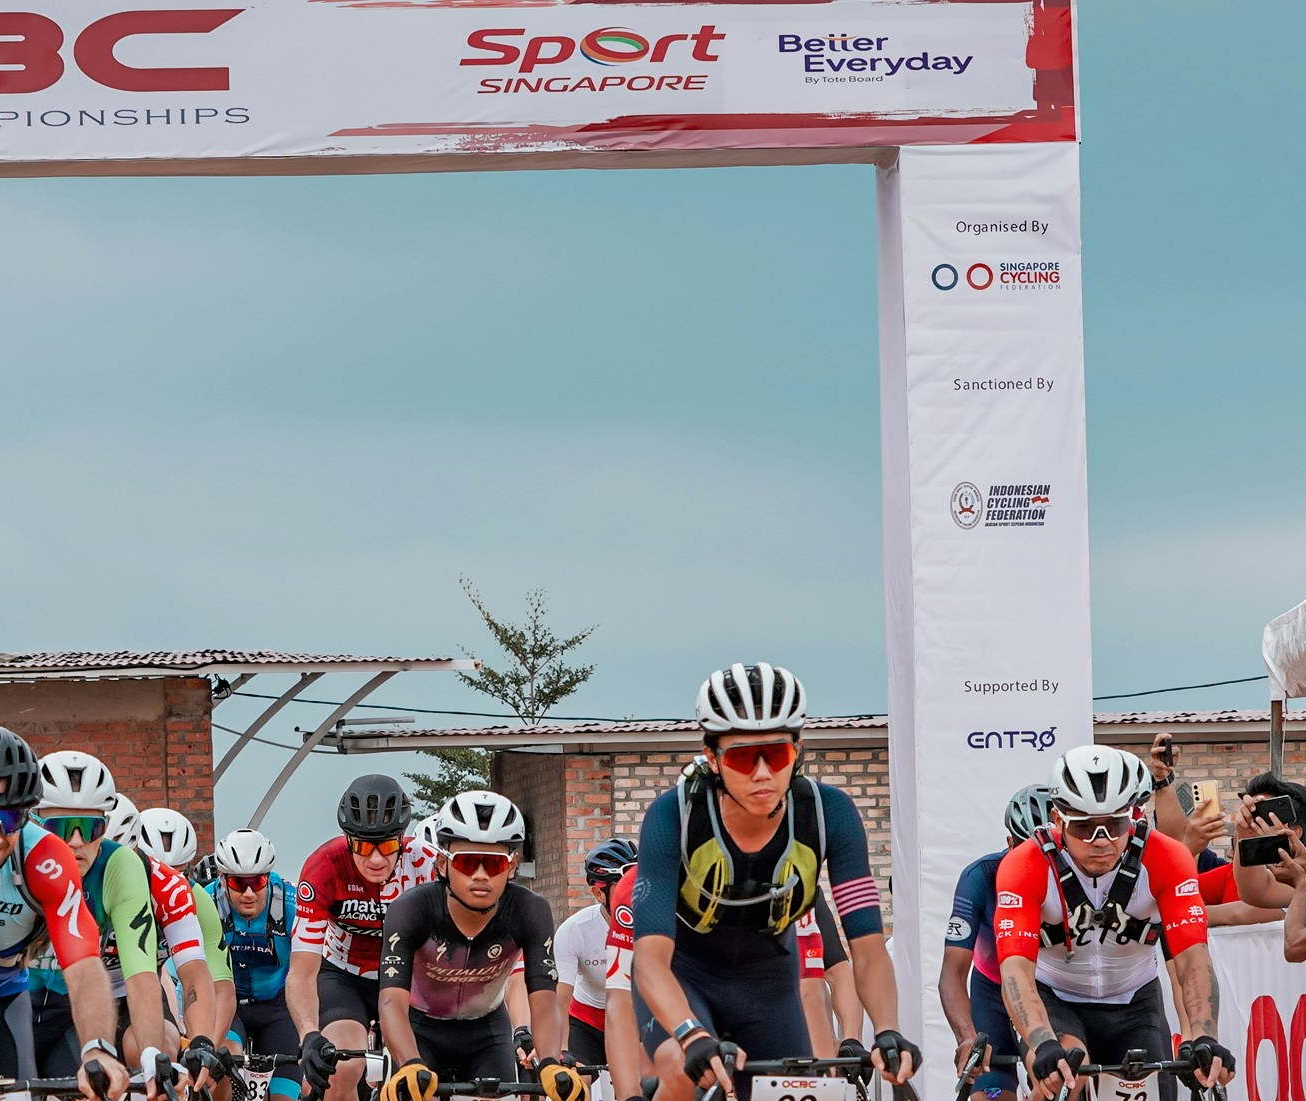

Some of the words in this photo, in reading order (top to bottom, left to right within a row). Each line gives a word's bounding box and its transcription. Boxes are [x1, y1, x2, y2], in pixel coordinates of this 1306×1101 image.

[458, 25, 726, 73] Sport
[778, 33, 889, 53] Better
[804, 52, 974, 76] Everyday
[477, 75, 709, 94] SINGAPORE
[805, 76, 820, 85] By
[848, 75, 884, 83] Board
[955, 220, 1027, 236] Organised
[1031, 220, 1049, 235] By
[999, 262, 1060, 271] SINGAPORE
[999, 271, 1060, 284] CYCLING
[953, 378, 1032, 391] Sanctioned
[1036, 378, 1054, 392] By
[988, 485, 1051, 496] INDONESIAN
[986, 497, 1031, 509] CYCLING
[985, 509, 1046, 520] FEDERATION
[964, 679, 1038, 695] Supported
[1042, 679, 1059, 694] By
[338, 912, 378, 921] RACING
[1166, 917, 1205, 931] BLACK
[248, 1080, 267, 1099] 83
[781, 1080, 818, 1088] OCBC
[1118, 1080, 1146, 1089] OCBC
